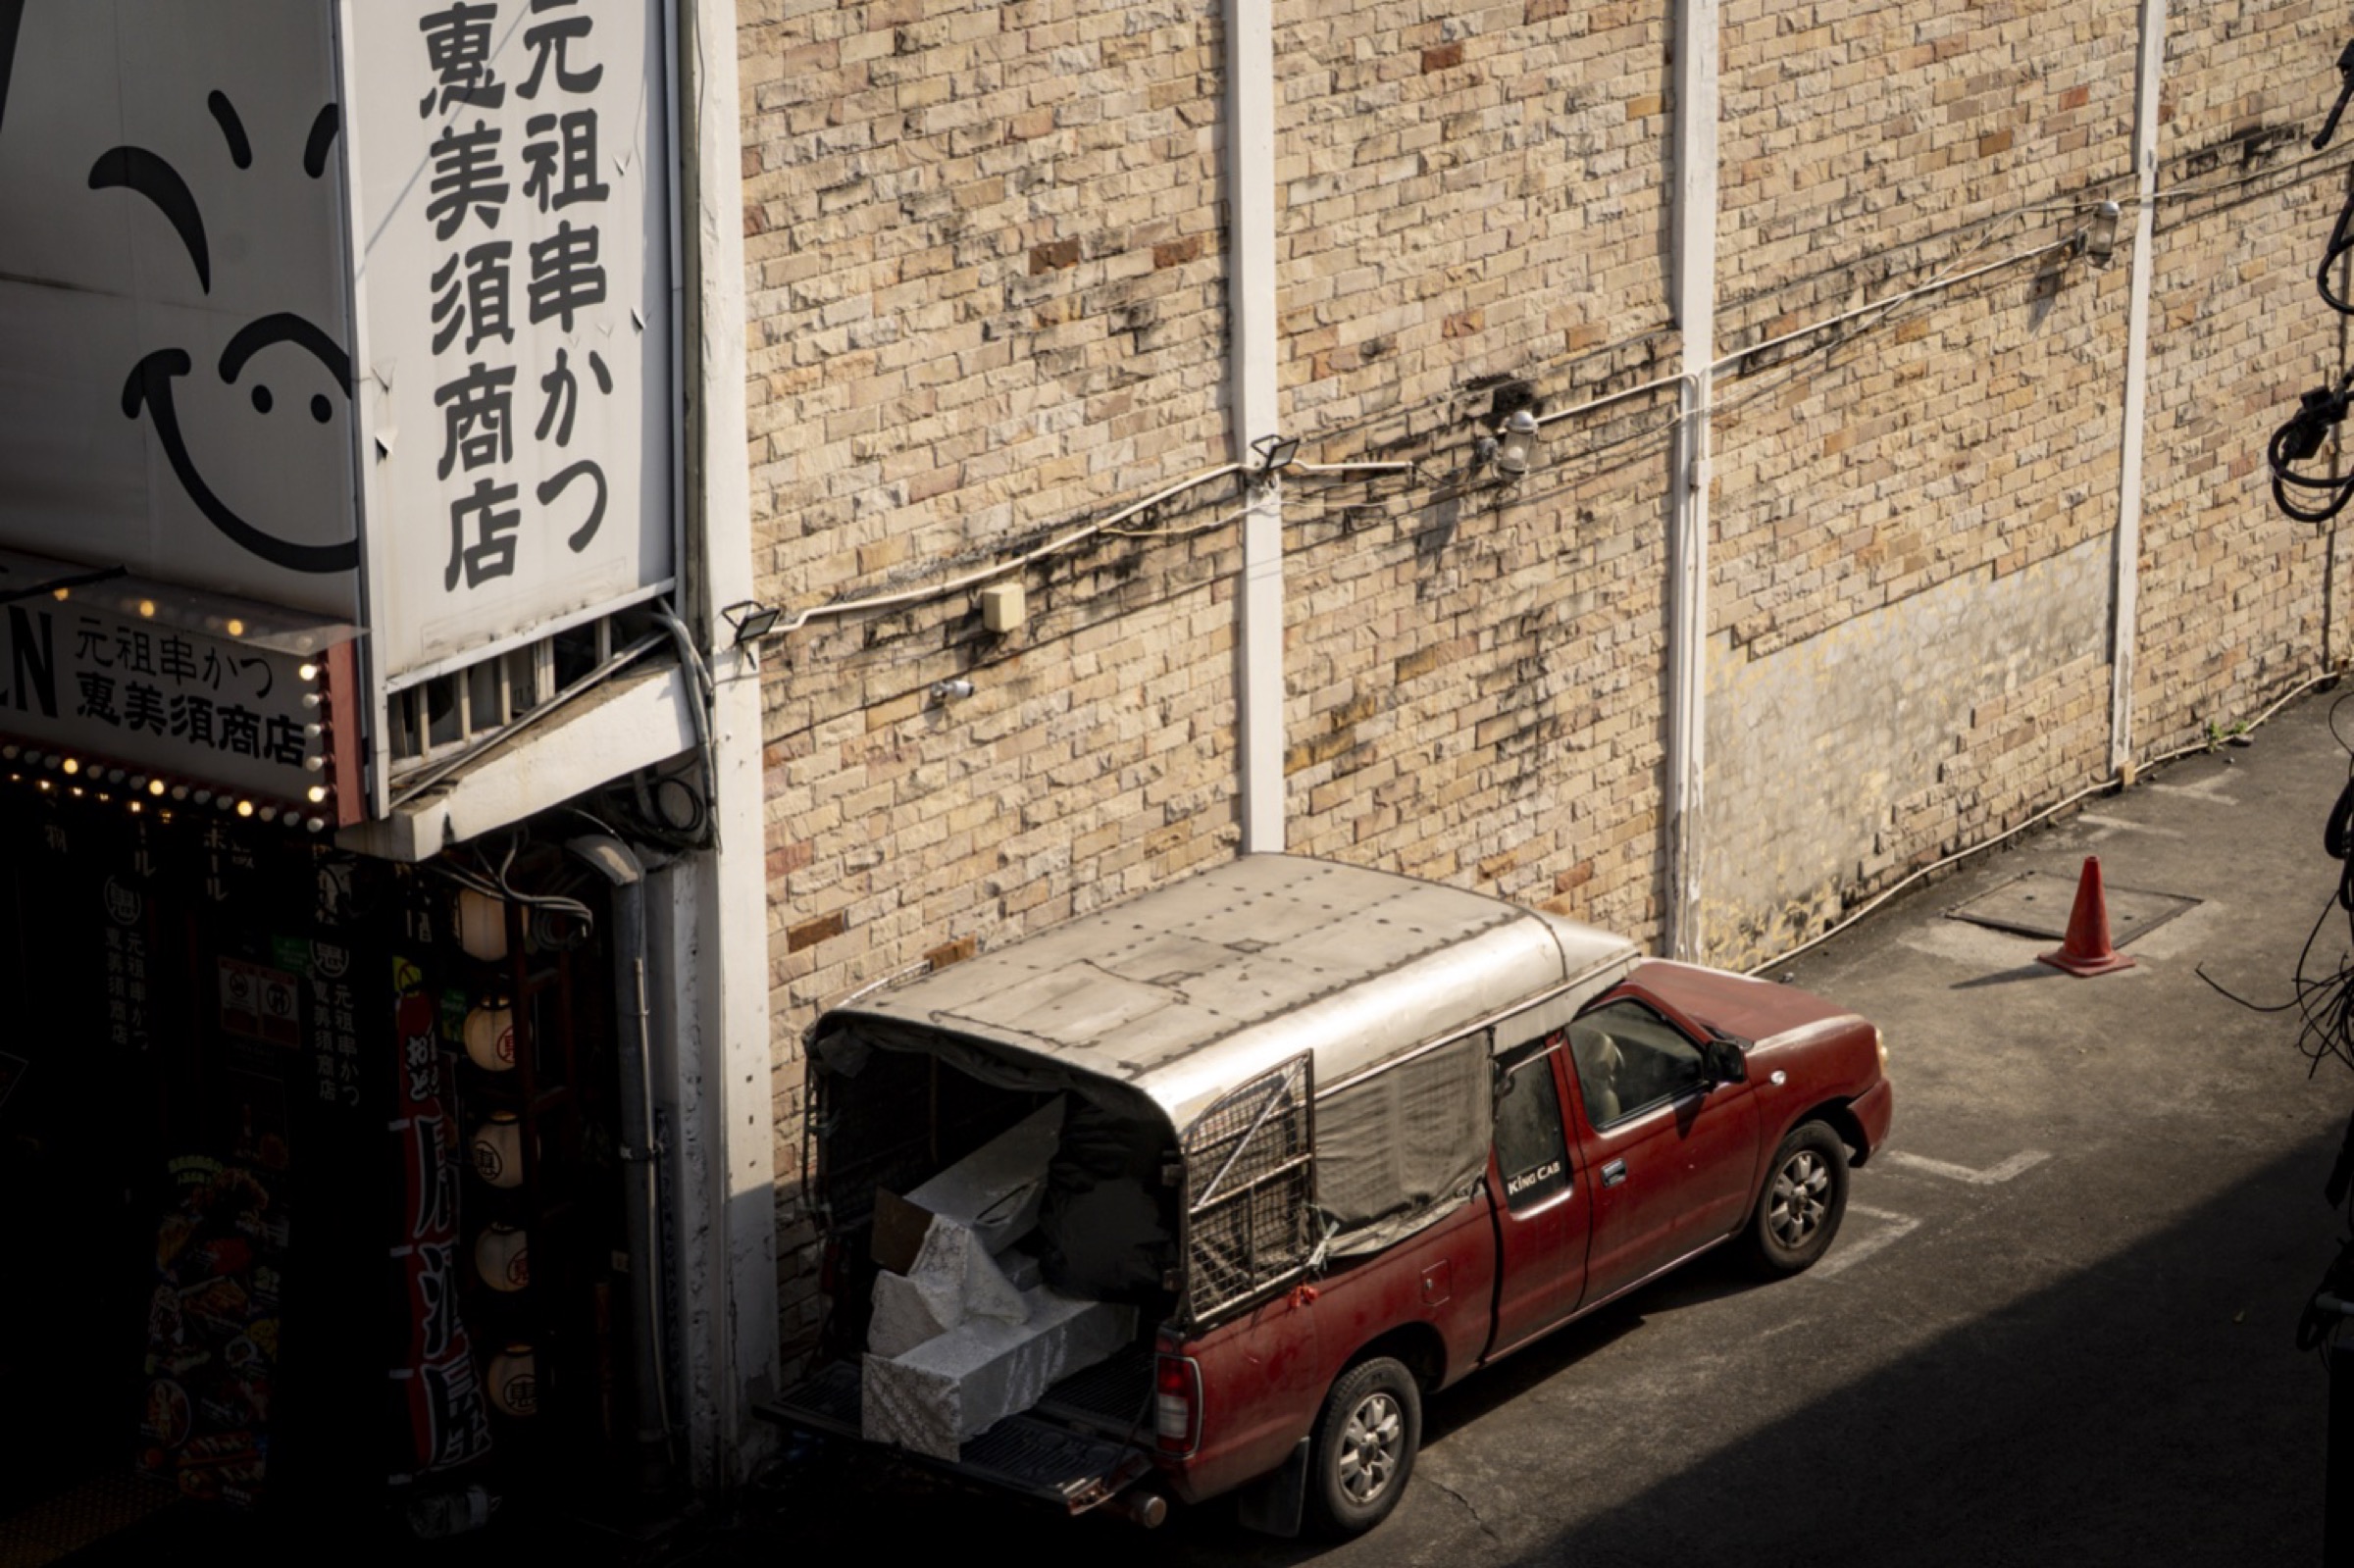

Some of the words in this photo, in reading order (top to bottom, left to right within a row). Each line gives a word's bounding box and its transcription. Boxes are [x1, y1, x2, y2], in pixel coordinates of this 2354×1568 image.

[516, 0, 612, 553] 元祖串かつ
[76, 617, 272, 699] 元祖串かつ
